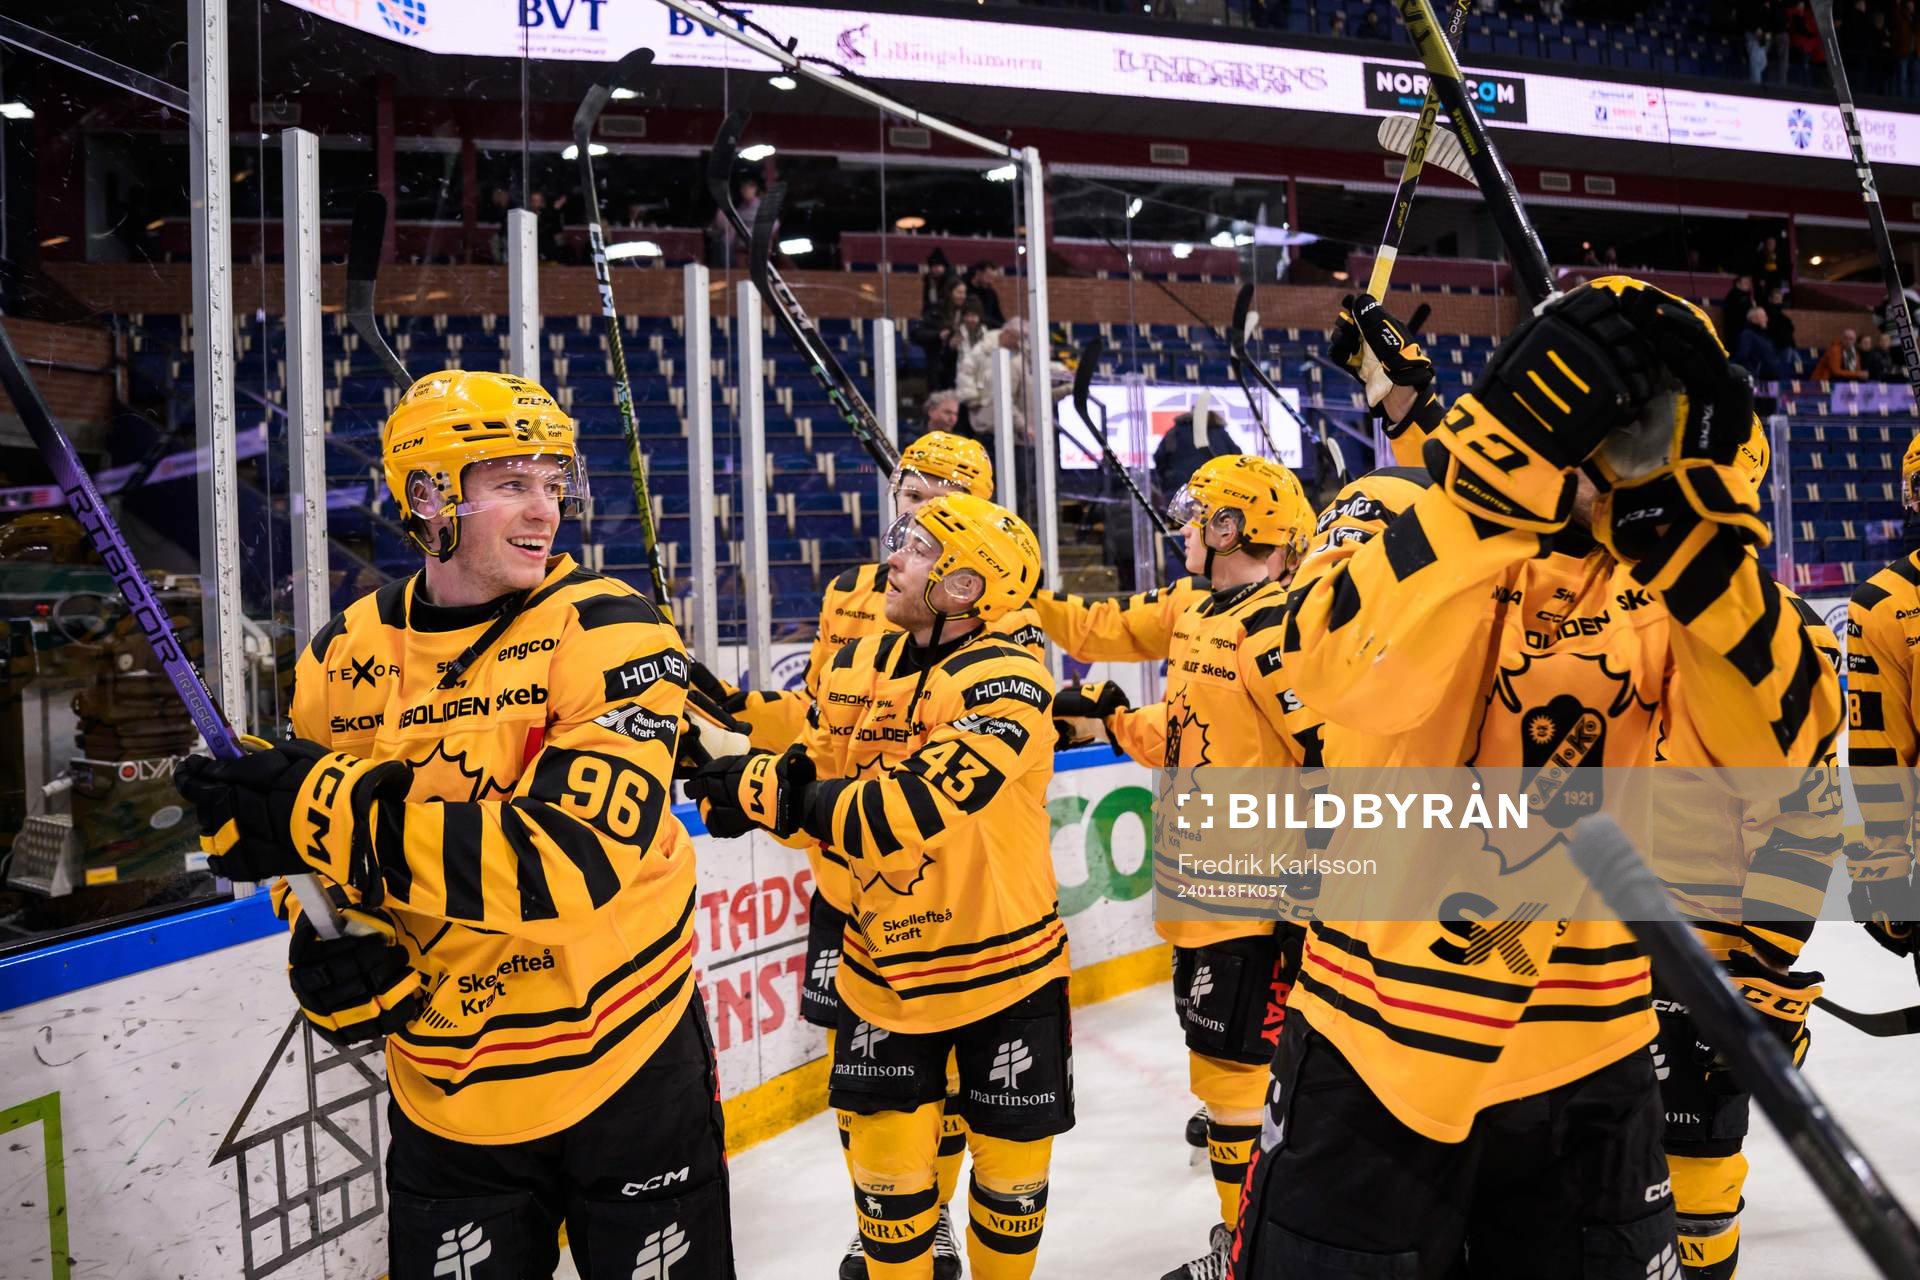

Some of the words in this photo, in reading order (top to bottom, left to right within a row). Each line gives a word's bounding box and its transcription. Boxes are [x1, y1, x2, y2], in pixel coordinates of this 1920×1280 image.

[392, 436, 425, 453] CCM
[1737, 442, 1758, 463] CM
[1223, 488, 1251, 501] CCM
[978, 549, 1004, 574] CCM
[64, 484, 180, 666] RIBCOR
[176, 667, 218, 736] TRIGGER
[974, 679, 1042, 703] HOLMEN
[631, 724, 657, 740] Kraft
[917, 740, 991, 803] 43
[560, 755, 650, 838] 96
[1562, 790, 1595, 806] 1921
[883, 907, 953, 934] Skellefteå
[884, 926, 922, 946] Kraft
[834, 1061, 916, 1078] martinsons
[969, 1087, 1057, 1106] martinsons
[621, 1166, 691, 1198] CCM
